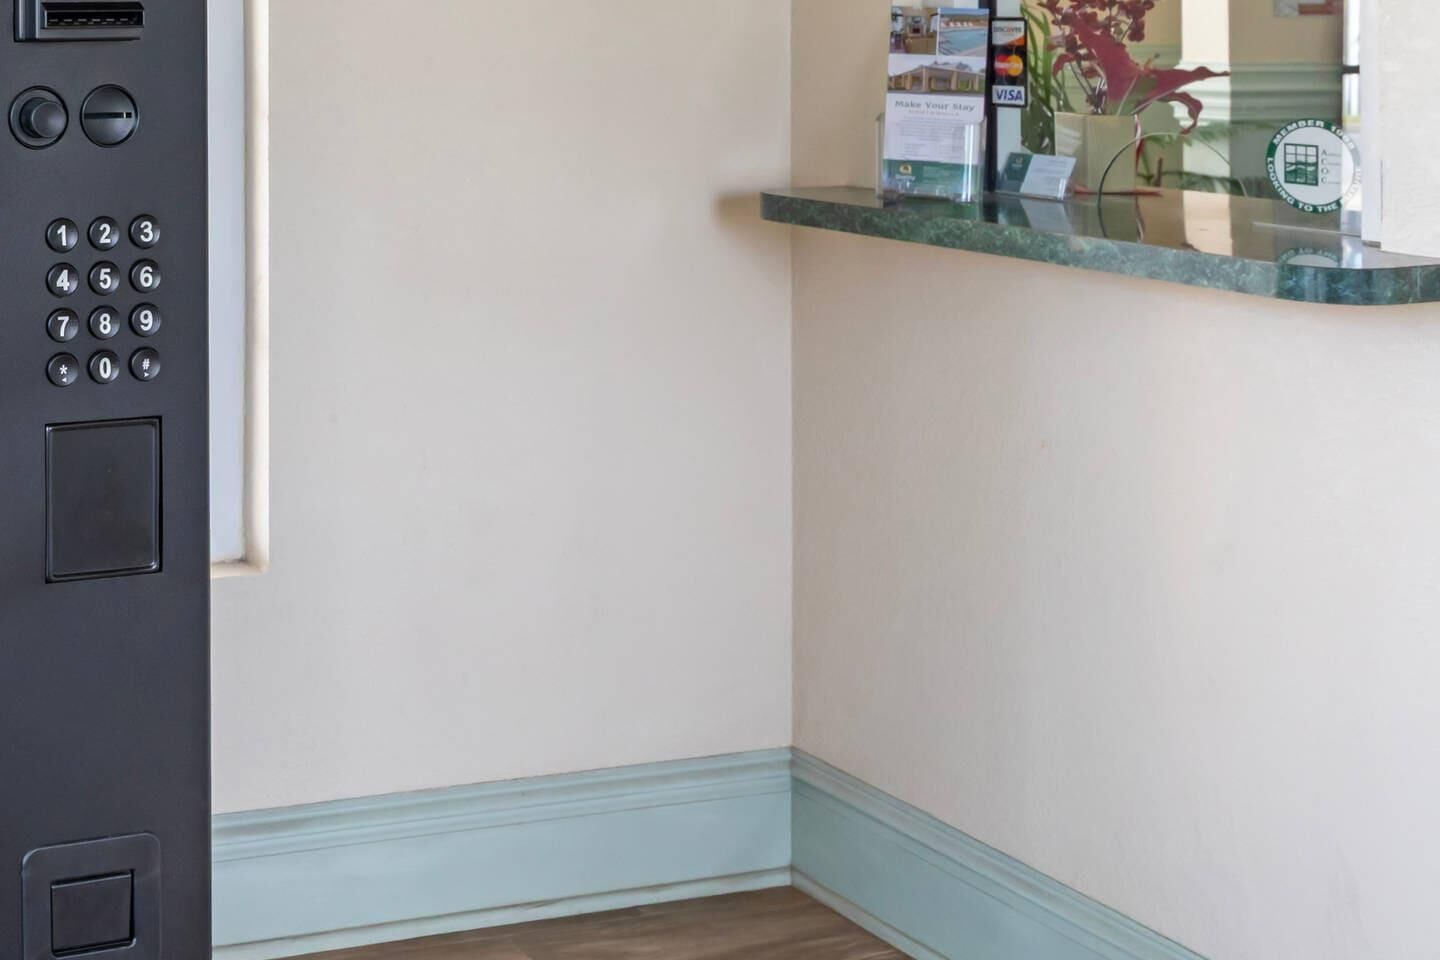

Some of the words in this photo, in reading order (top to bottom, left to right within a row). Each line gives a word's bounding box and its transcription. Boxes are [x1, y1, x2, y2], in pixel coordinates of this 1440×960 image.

[894, 99, 922, 109] Make
[924, 100, 949, 111] Your
[952, 103, 976, 113] Stay
[995, 90, 1024, 102] VISA
[1272, 119, 1325, 145] MEMBER
[1266, 157, 1296, 206] LOOKING
[1297, 202, 1314, 212] TO
[1317, 204, 1339, 213] THE
[57, 224, 67, 247] 1
[99, 223, 111, 243] 2
[139, 220, 153, 242] 3
[56, 269, 70, 291] 4
[99, 268, 111, 289] 5
[139, 266, 153, 287] 6
[57, 315, 70, 337] 7
[99, 313, 111, 334] 8
[139, 310, 153, 331] 9
[99, 357, 111, 379] 0
